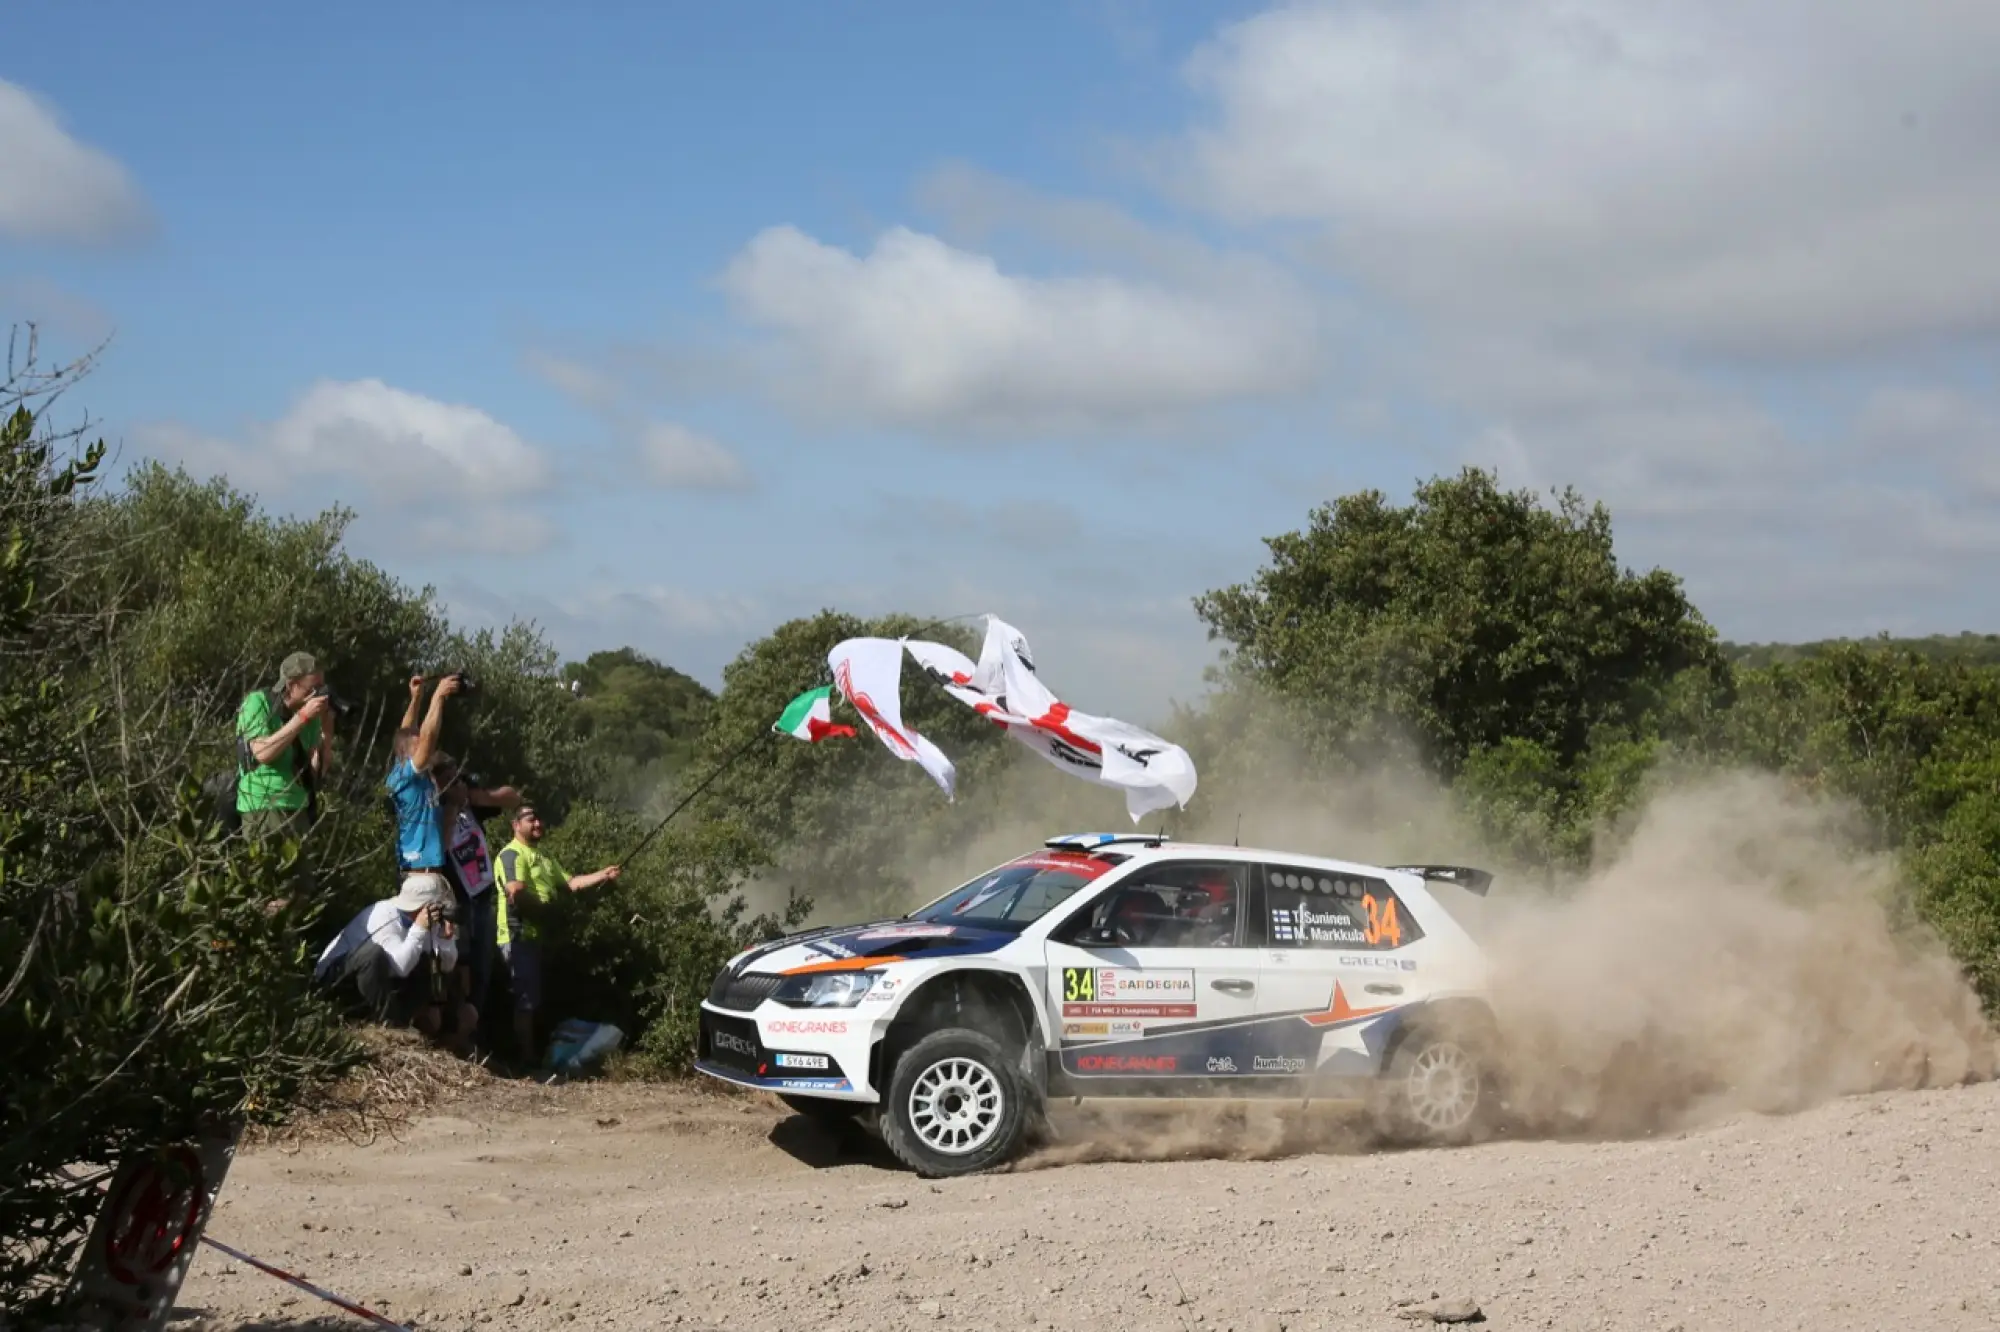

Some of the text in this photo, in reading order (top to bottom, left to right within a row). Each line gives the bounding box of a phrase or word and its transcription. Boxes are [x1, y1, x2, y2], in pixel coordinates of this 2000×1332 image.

[1304, 910, 1350, 926] Suninen
[1361, 894, 1400, 947] 34
[1311, 927, 1365, 942] Markkula
[1066, 968, 1093, 1001] 34
[1118, 979, 1191, 989] SARDEGNA
